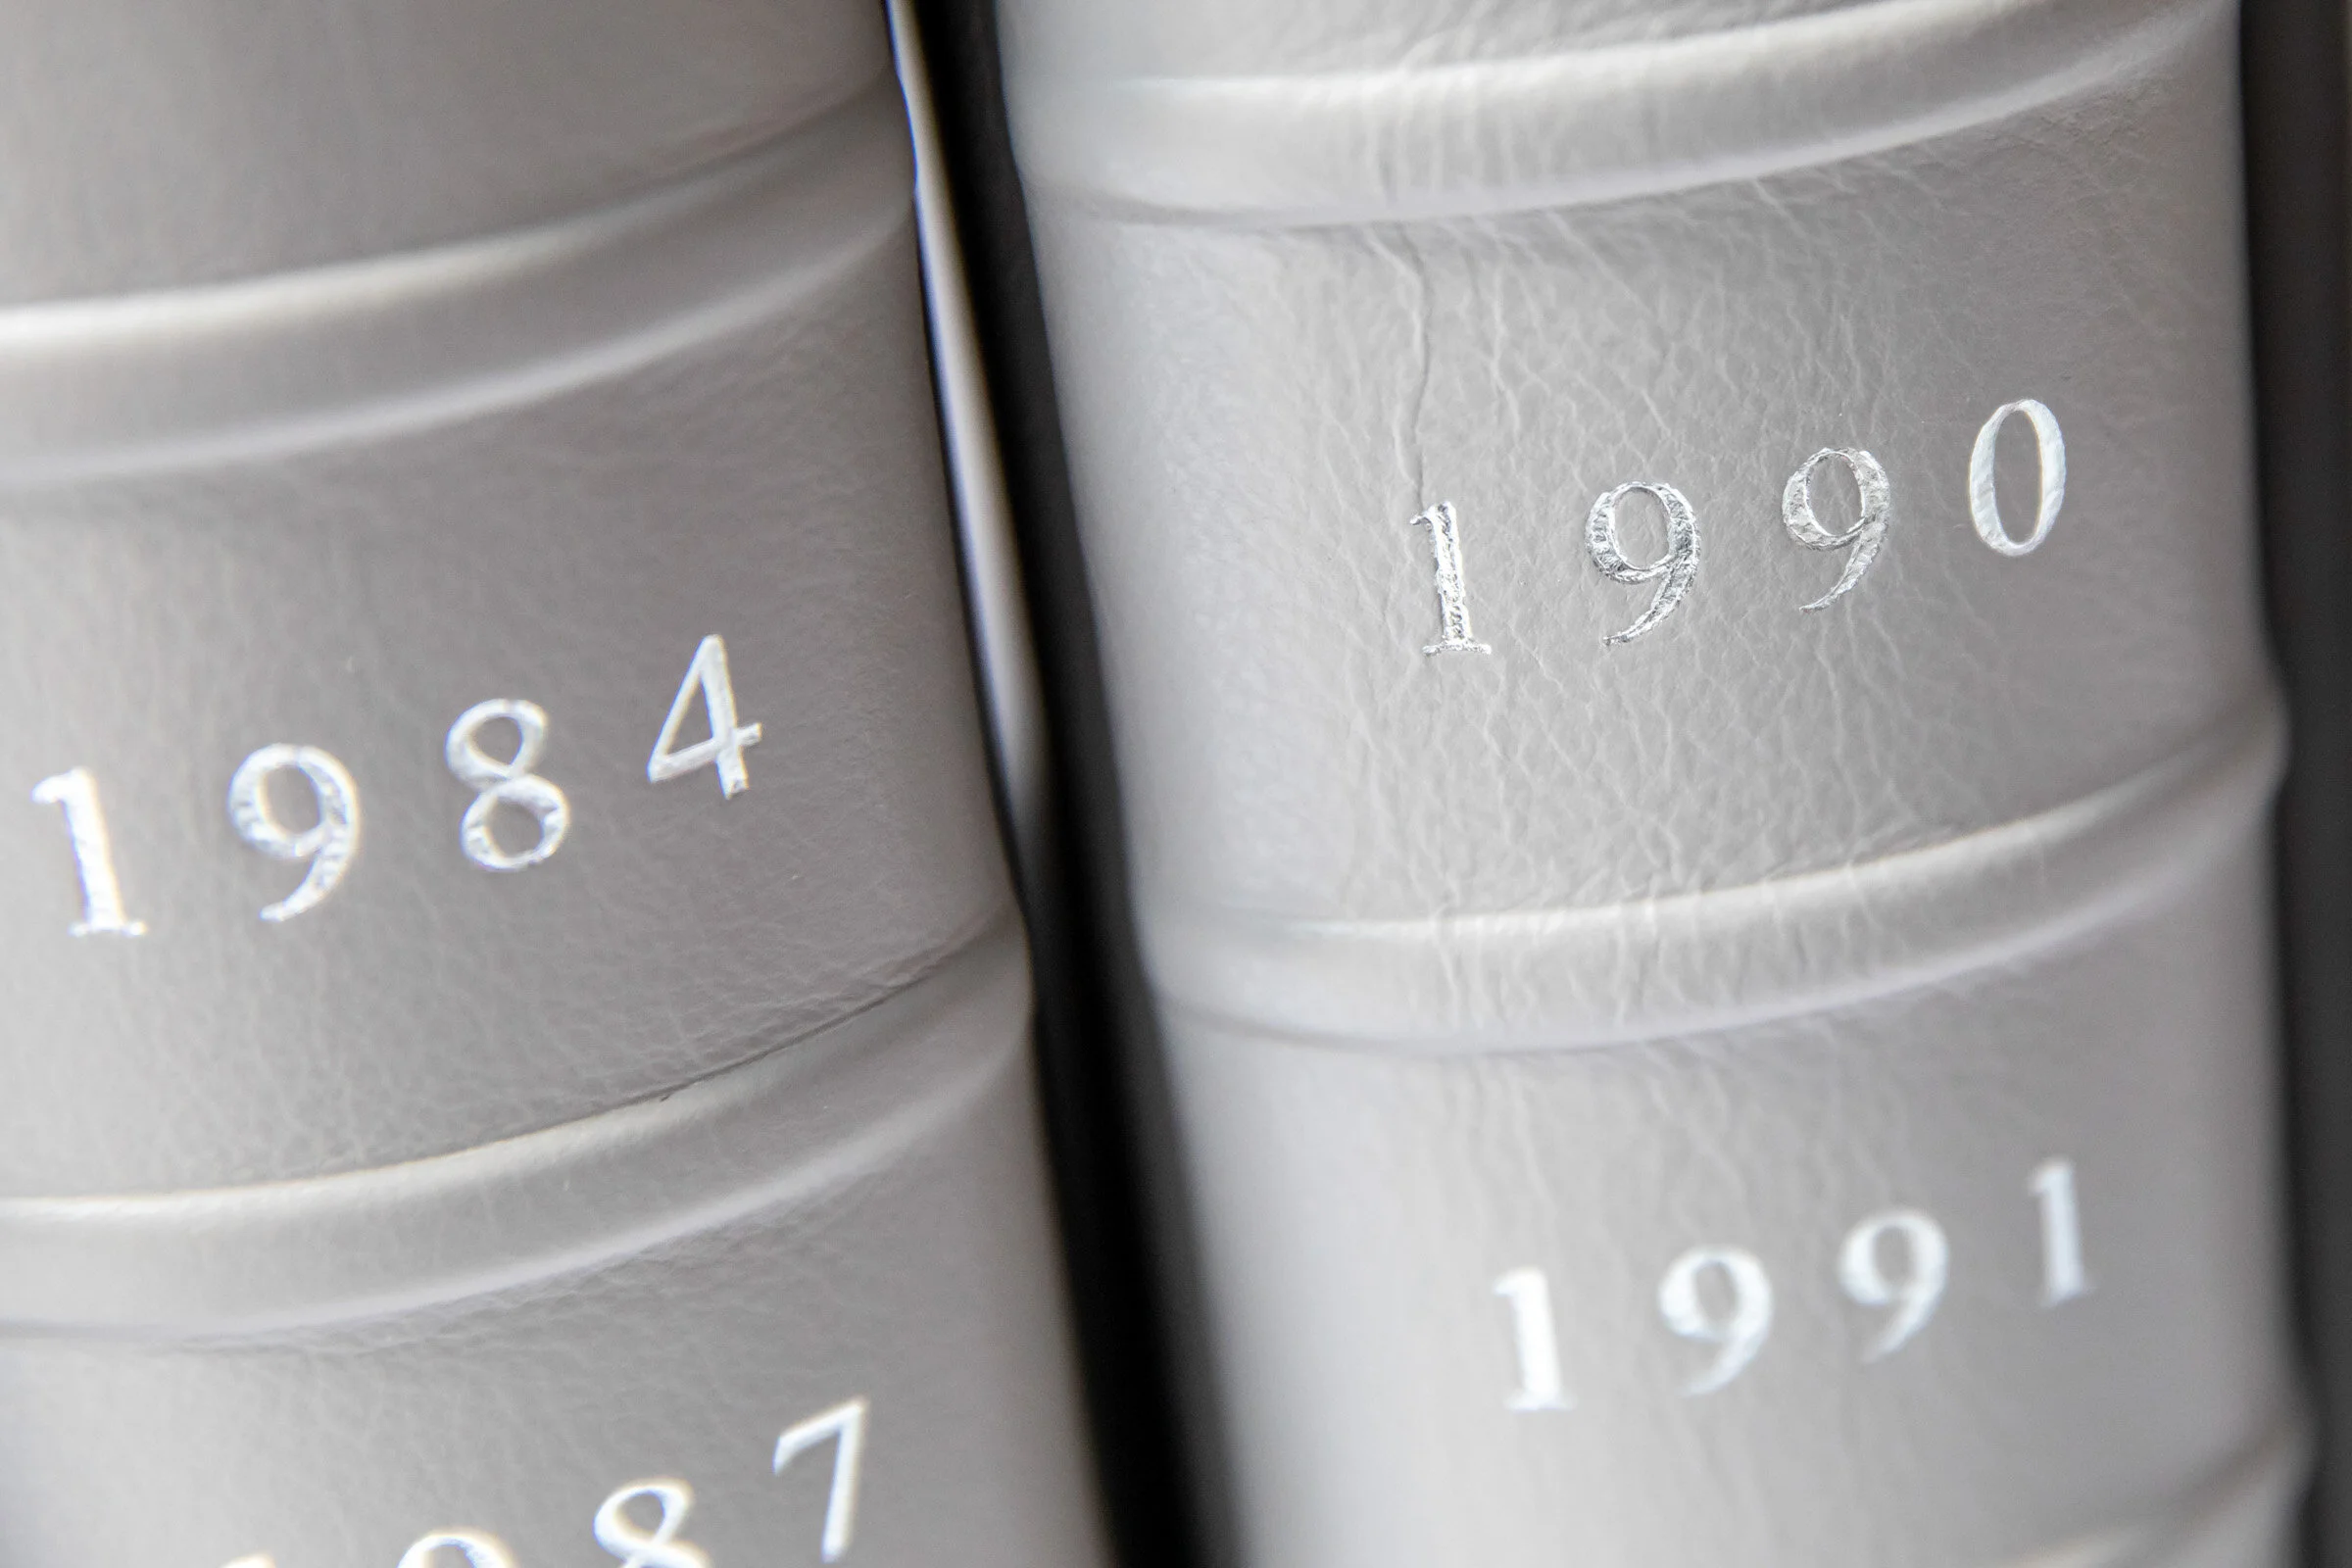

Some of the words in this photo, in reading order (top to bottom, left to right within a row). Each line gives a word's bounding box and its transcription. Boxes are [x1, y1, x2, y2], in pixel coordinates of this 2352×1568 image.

[1409, 398, 2067, 657] 1990
[31, 633, 762, 937] 1984
[1492, 1155, 2092, 1412] 1991
[218, 1396, 870, 1568] 87
